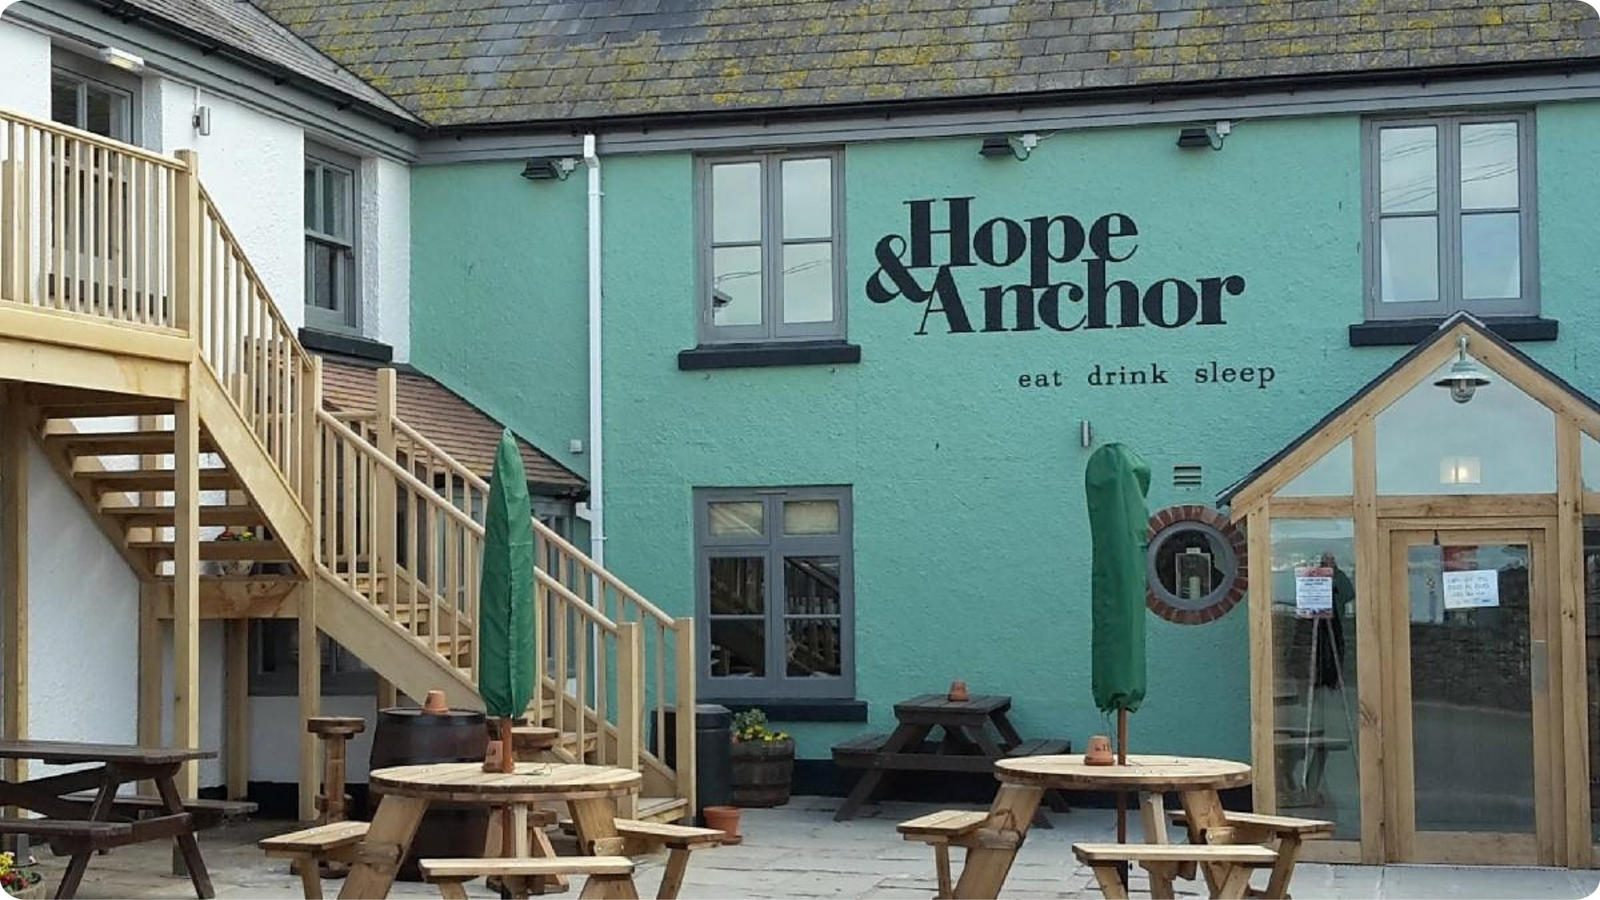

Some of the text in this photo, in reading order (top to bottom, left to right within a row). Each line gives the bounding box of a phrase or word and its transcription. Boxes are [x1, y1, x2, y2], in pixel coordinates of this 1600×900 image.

[865, 233, 1246, 335] & Anchor
[903, 196, 1139, 289] Hope
[1018, 361, 1276, 389] eat drink sleep
